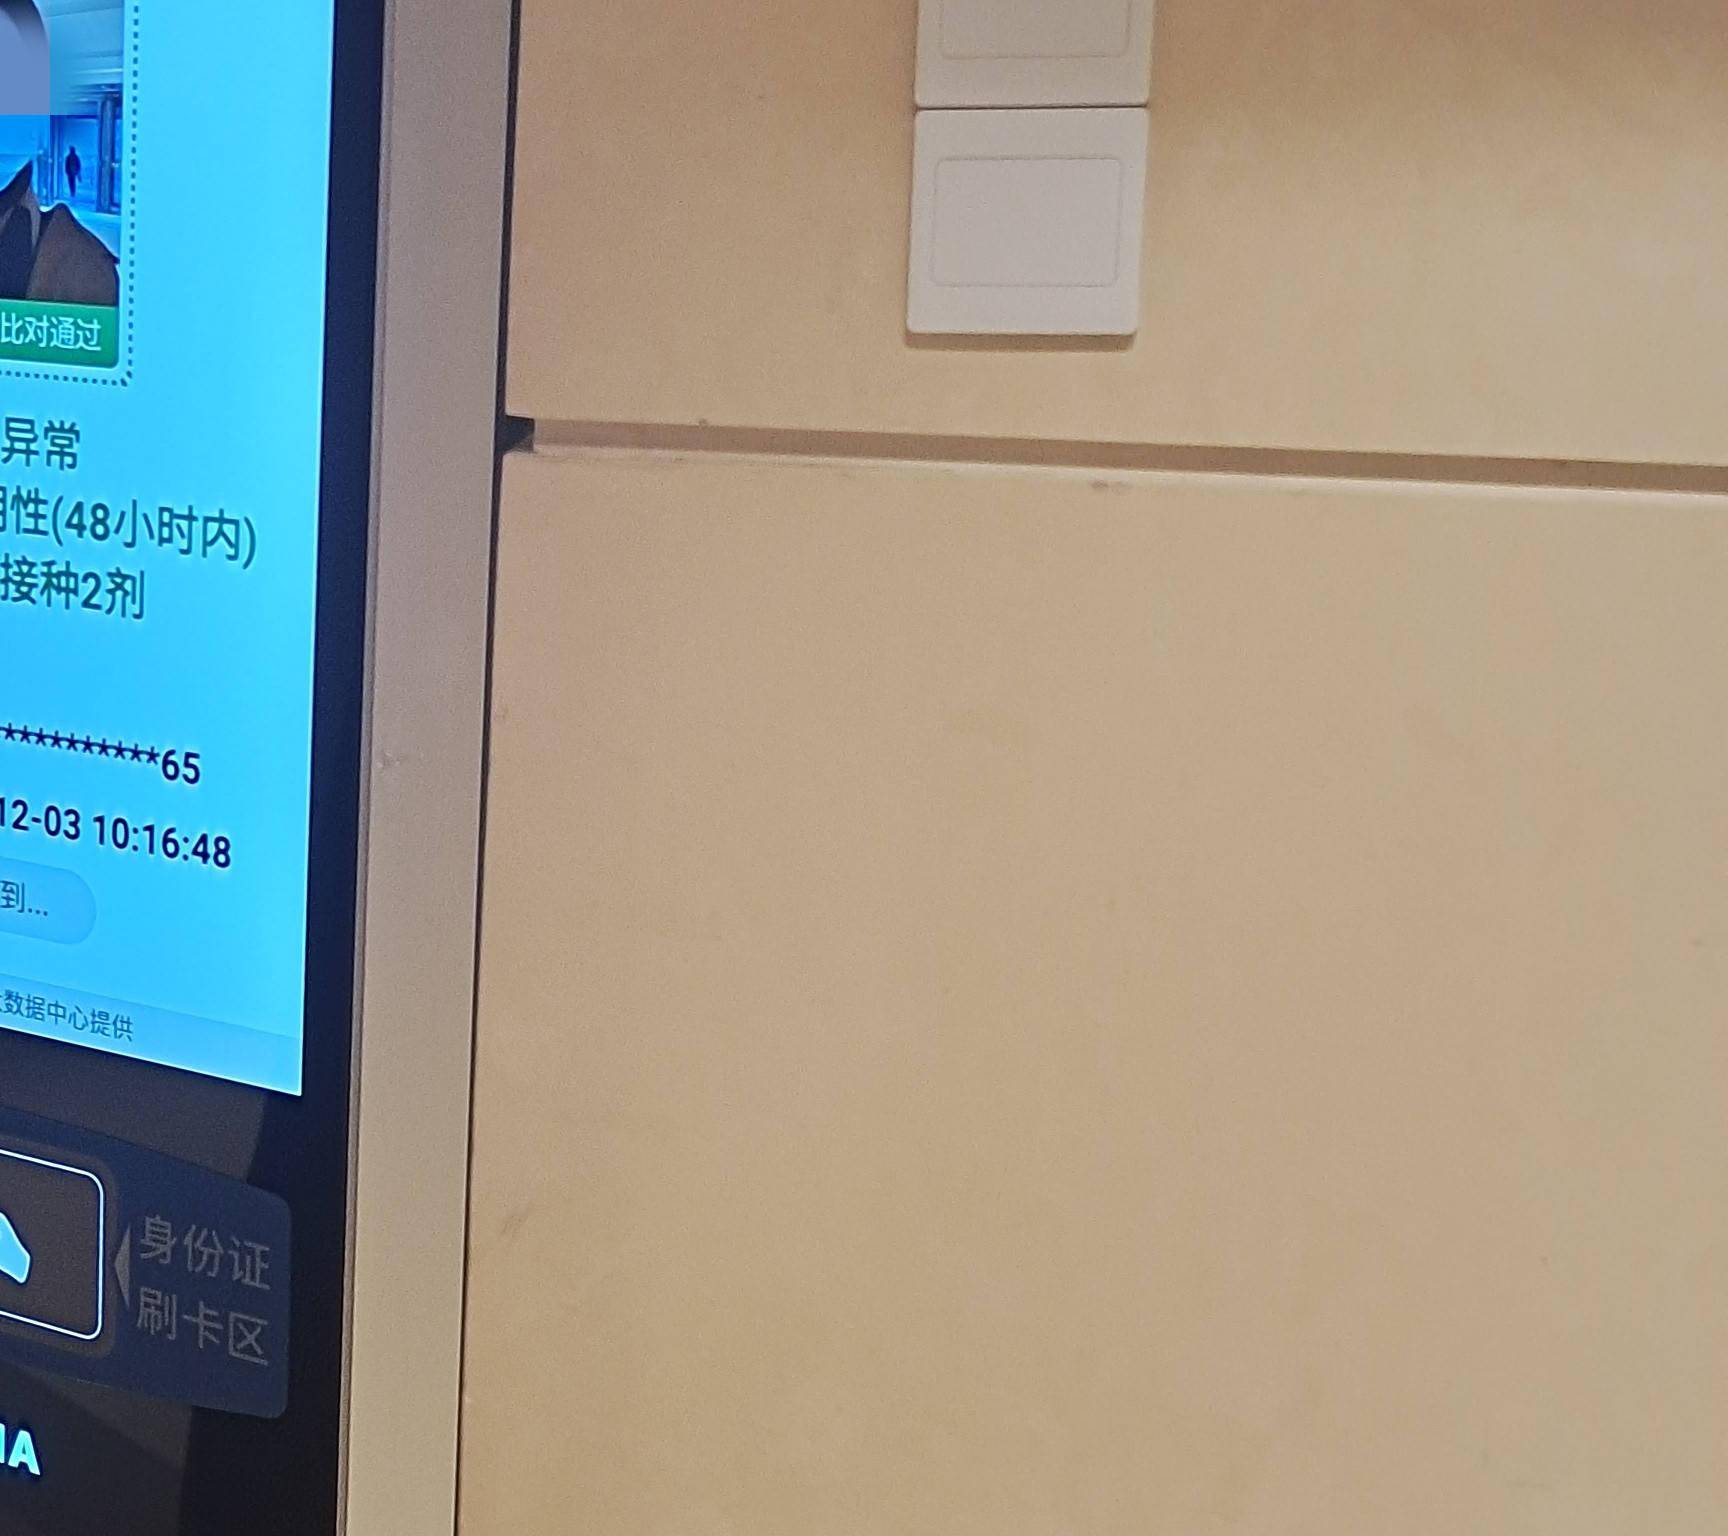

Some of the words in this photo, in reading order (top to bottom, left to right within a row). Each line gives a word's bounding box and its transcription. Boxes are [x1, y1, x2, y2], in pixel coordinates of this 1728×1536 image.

[92, 814, 232, 869] 10:16:48
[138, 1213, 272, 1292] 身份证
[136, 1285, 271, 1367] 刷卡区
